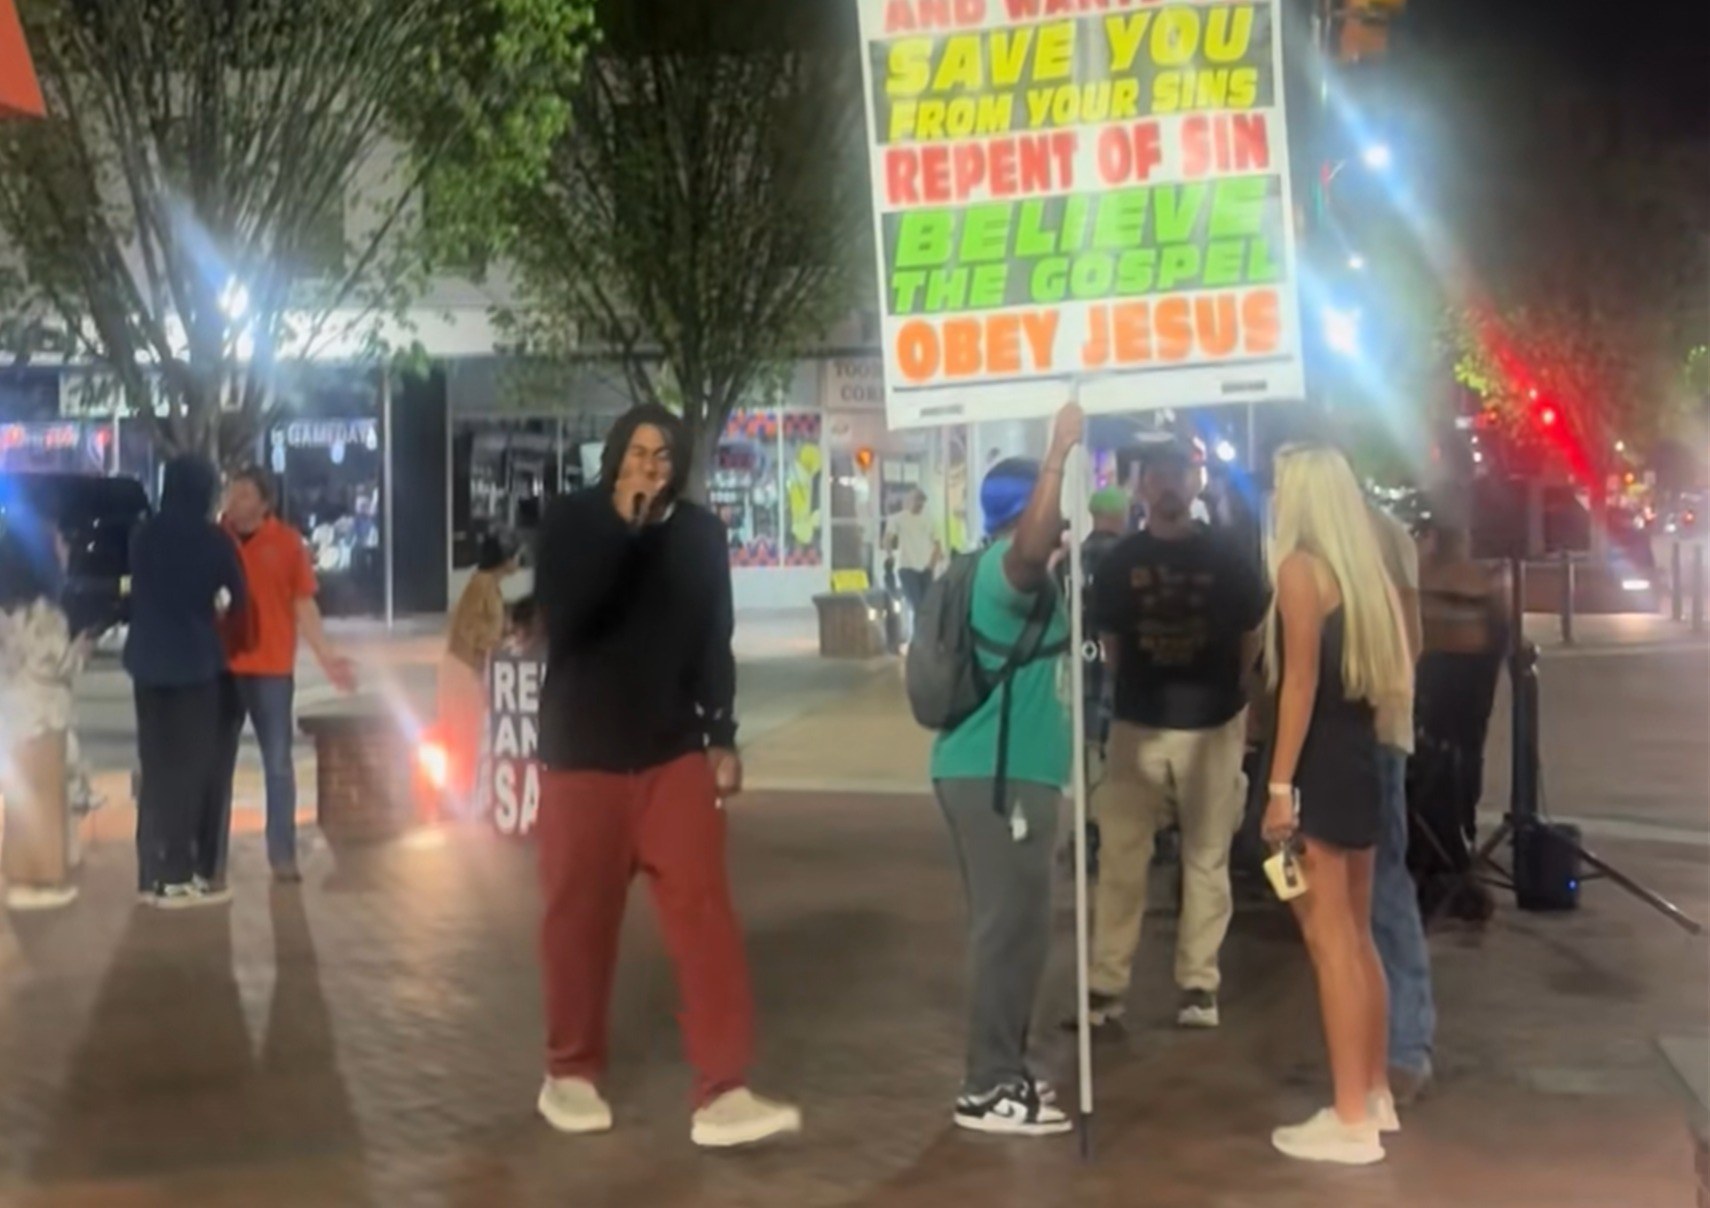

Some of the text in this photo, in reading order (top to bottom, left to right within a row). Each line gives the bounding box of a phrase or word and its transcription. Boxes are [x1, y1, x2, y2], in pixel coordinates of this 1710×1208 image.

[886, 5, 1254, 97] SAVE YOU
[889, 67, 1258, 145] FROM YOUR SINS
[885, 112, 1271, 205] REPENT OF SIN
[895, 176, 1269, 267] BELIEVE
[892, 238, 1278, 315] THE GOSPEL
[896, 289, 1281, 383] OBEY JESUS
[493, 661, 547, 713] RE
